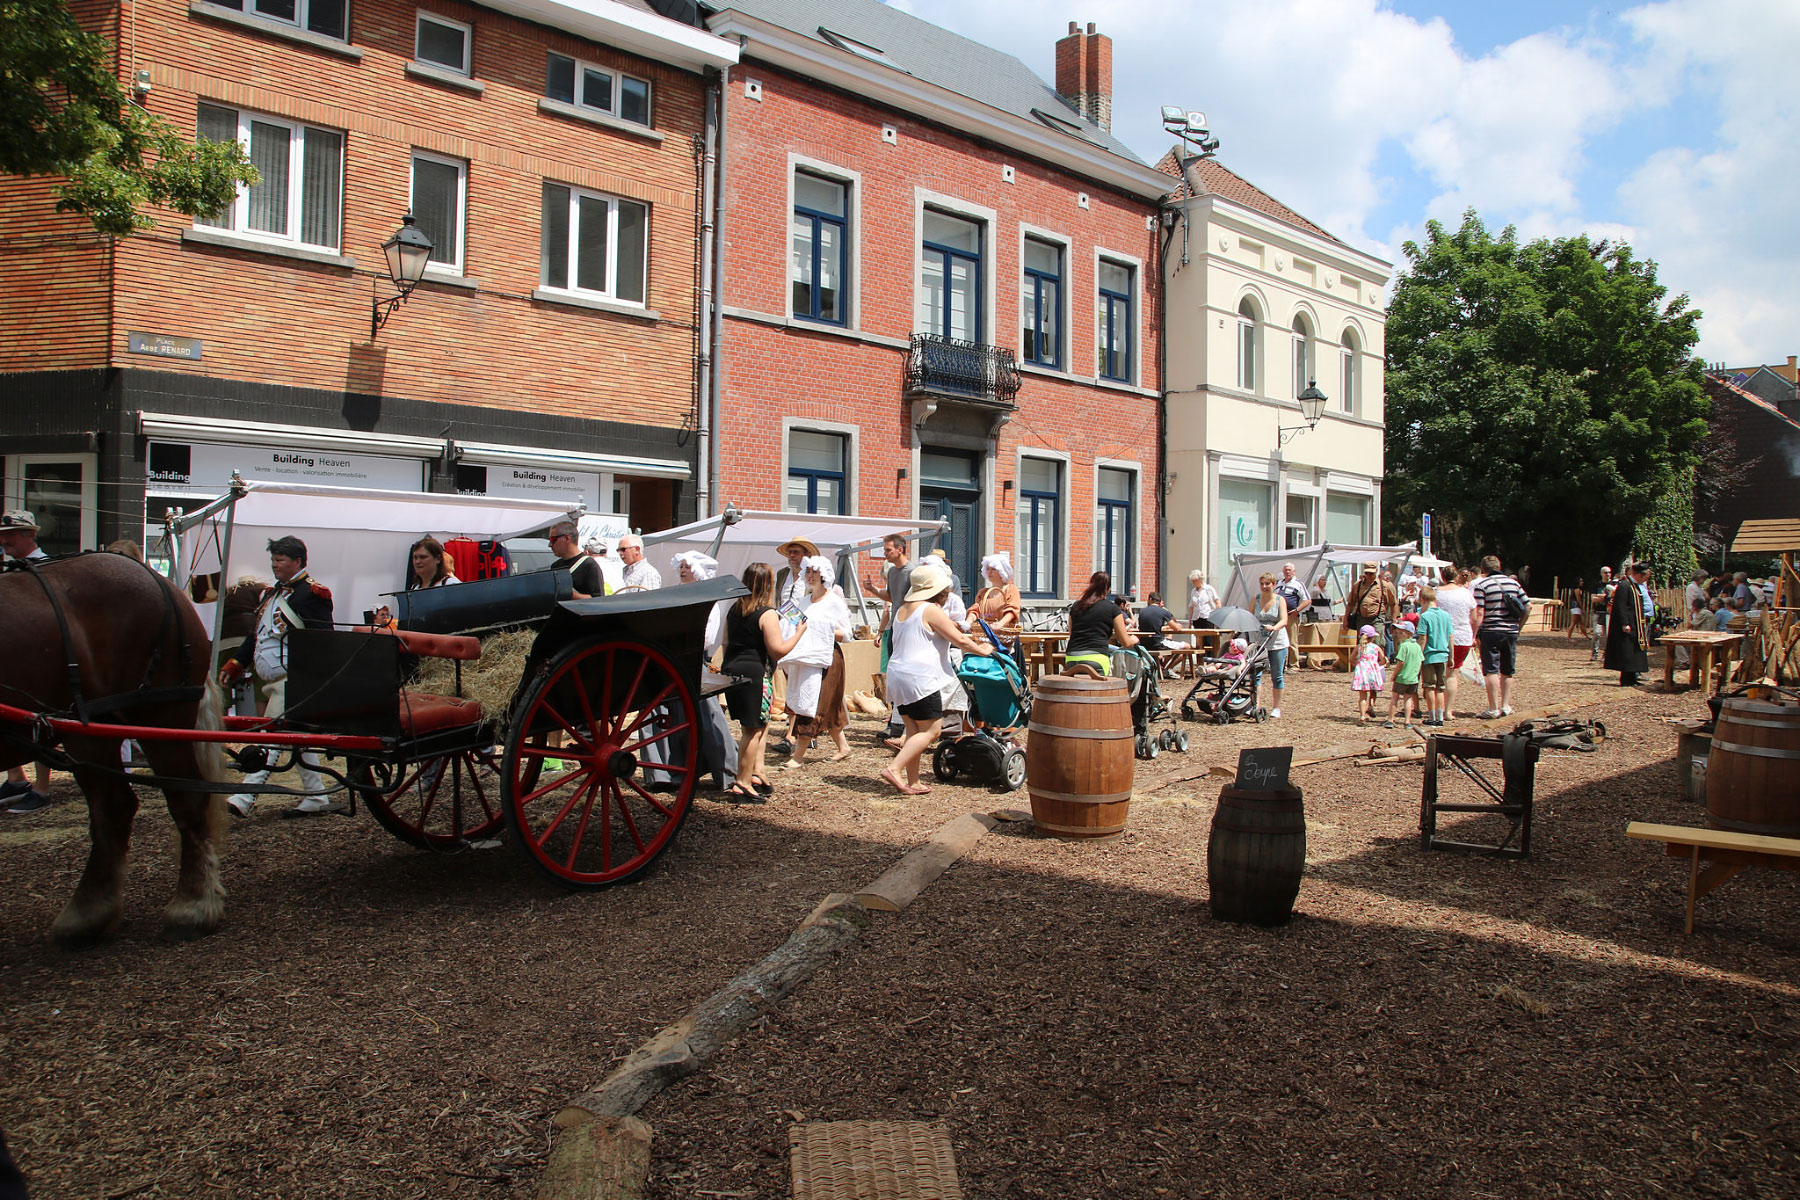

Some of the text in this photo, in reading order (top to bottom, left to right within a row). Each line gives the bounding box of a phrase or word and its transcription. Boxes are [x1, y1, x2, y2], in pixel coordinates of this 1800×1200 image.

[161, 345, 191, 356] RENARD
[273, 454, 351, 467] Building Heaven
[149, 470, 191, 483] Building
[513, 470, 576, 483] Building Heaven
